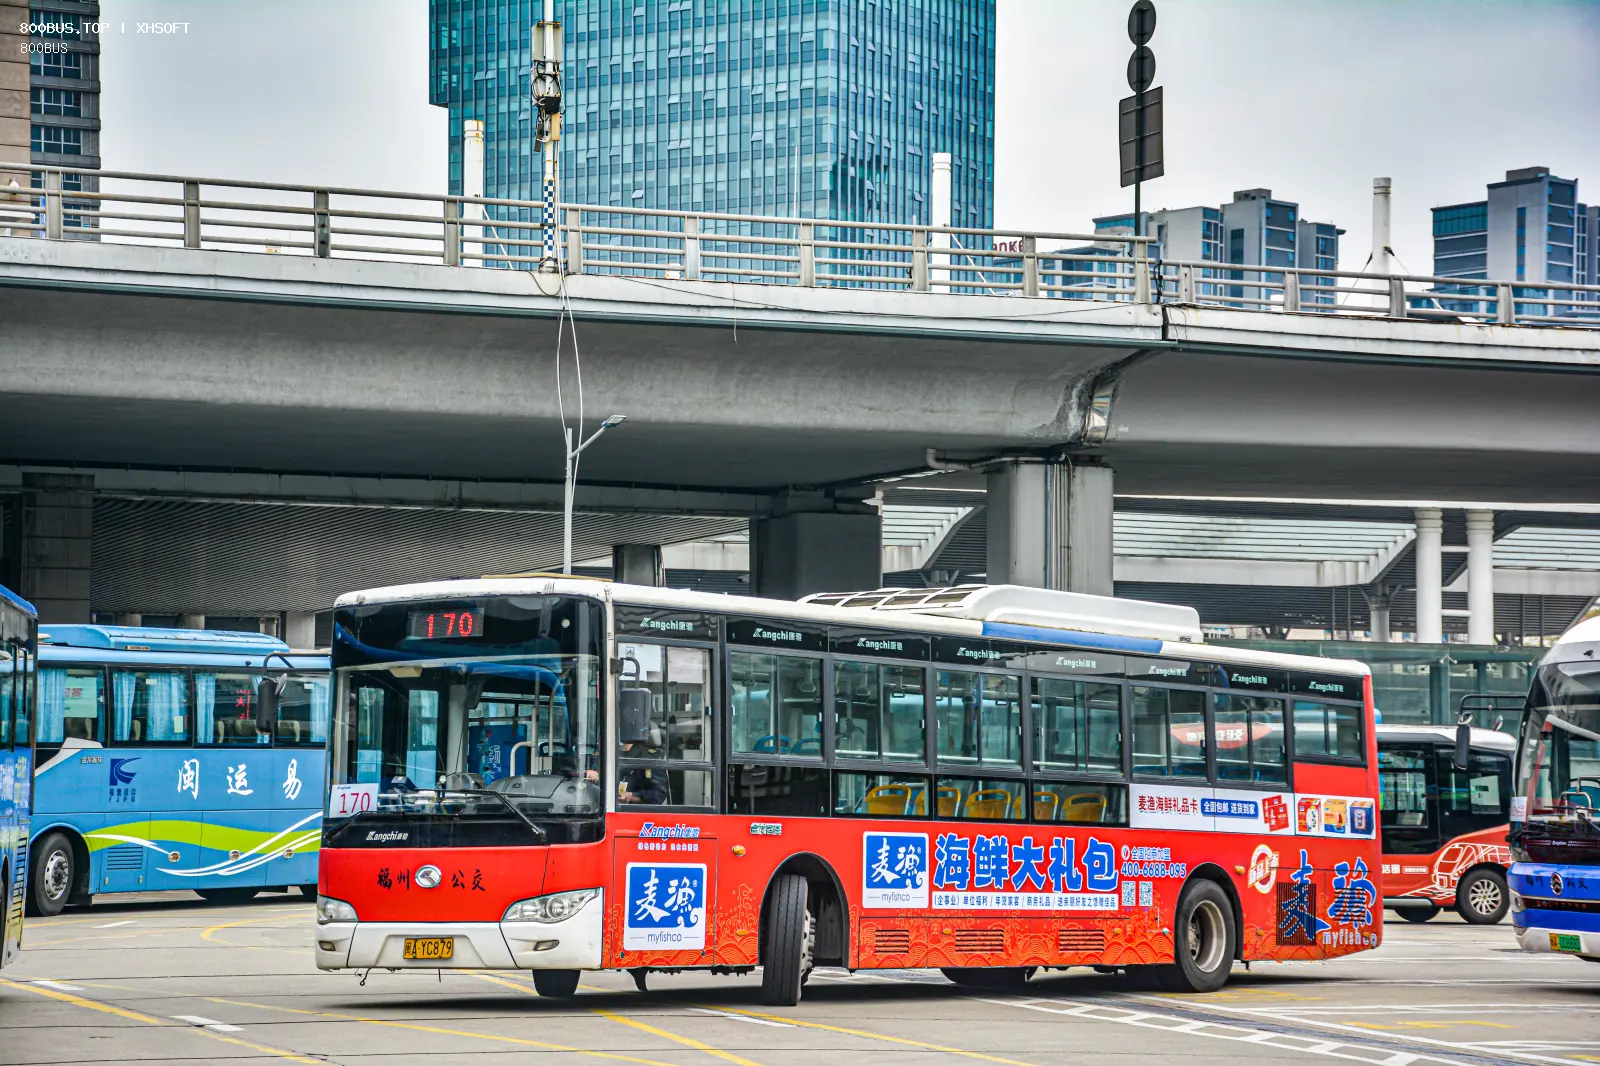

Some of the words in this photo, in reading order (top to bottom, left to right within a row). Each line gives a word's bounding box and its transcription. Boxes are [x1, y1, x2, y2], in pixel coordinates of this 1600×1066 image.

[426, 611, 473, 640] 170
[339, 792, 371, 814] 170
[1138, 795, 1198, 813] 麦渔海鲜礼品卡
[933, 832, 1119, 893] 海鲜大礼包
[1121, 862, 1187, 878] 400-6688-095
[377, 868, 411, 891] 福州
[451, 868, 486, 892] 公交
[881, 891, 911, 903] myfishco
[647, 931, 683, 944] myfishco
